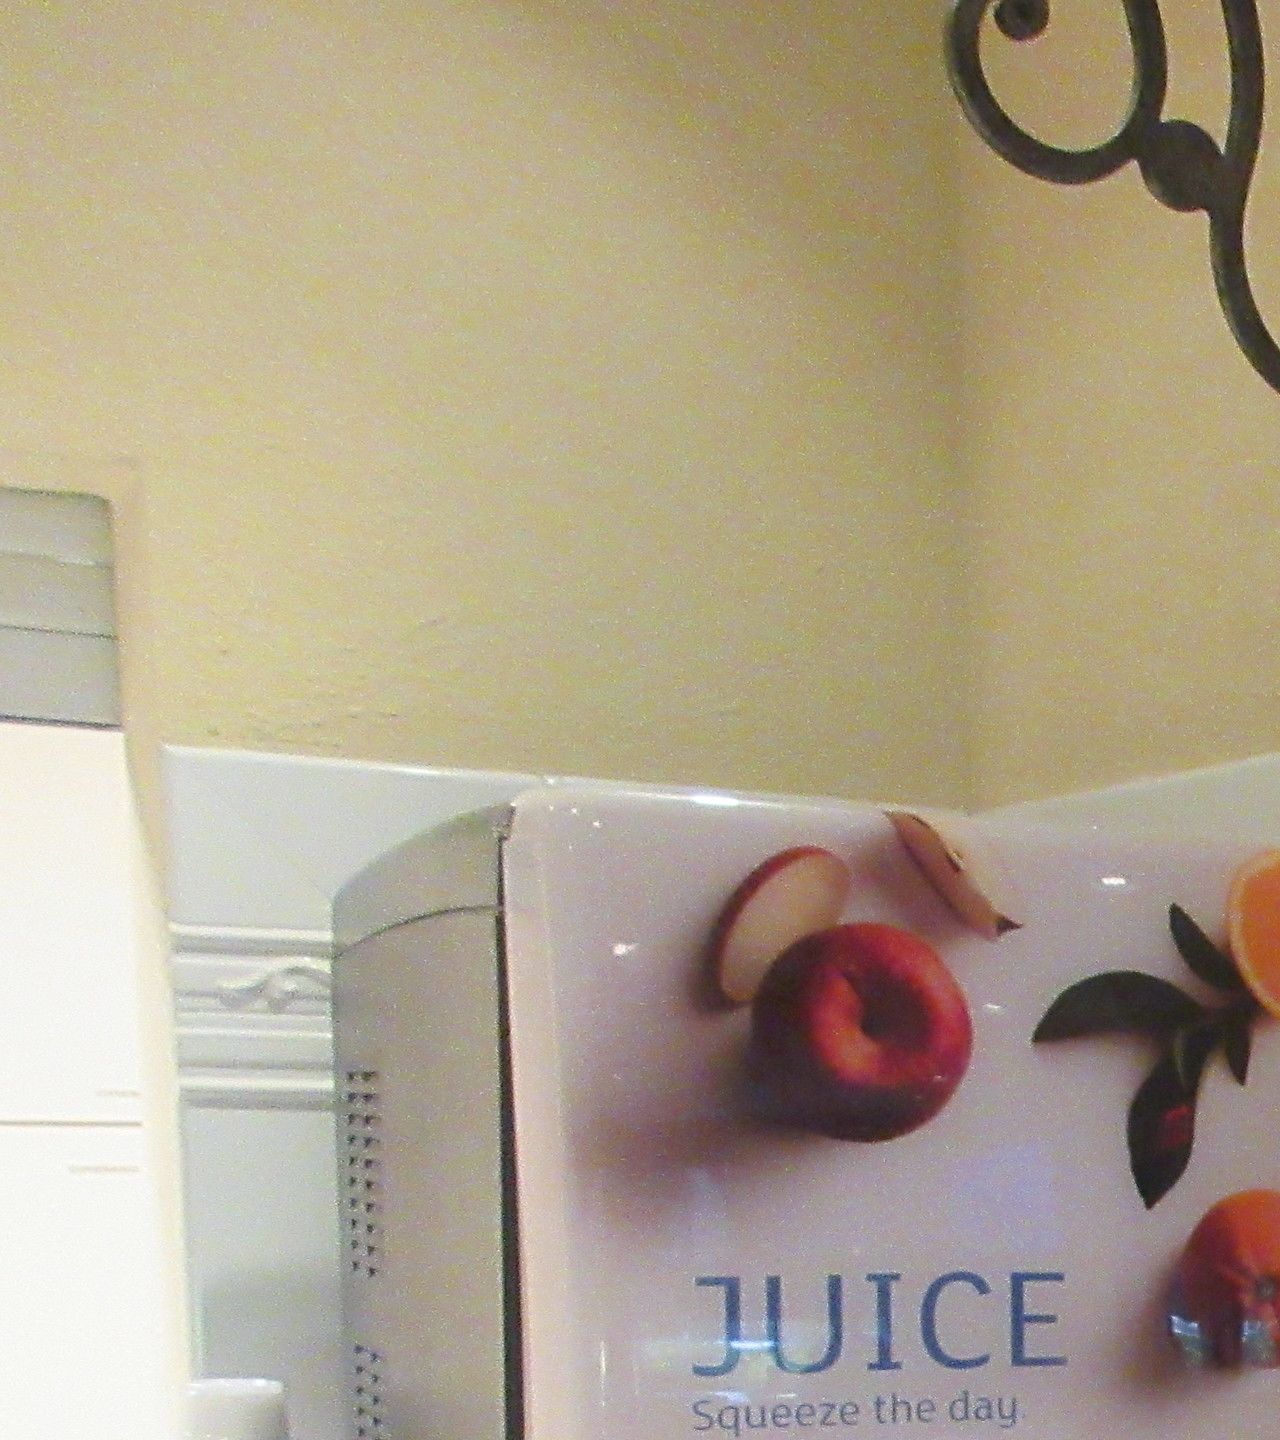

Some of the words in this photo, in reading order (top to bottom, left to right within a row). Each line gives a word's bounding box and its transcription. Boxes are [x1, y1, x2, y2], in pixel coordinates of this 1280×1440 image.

[692, 1271, 1068, 1377] JUICE
[692, 1399, 860, 1437] Squeeze
[873, 1392, 936, 1424] the
